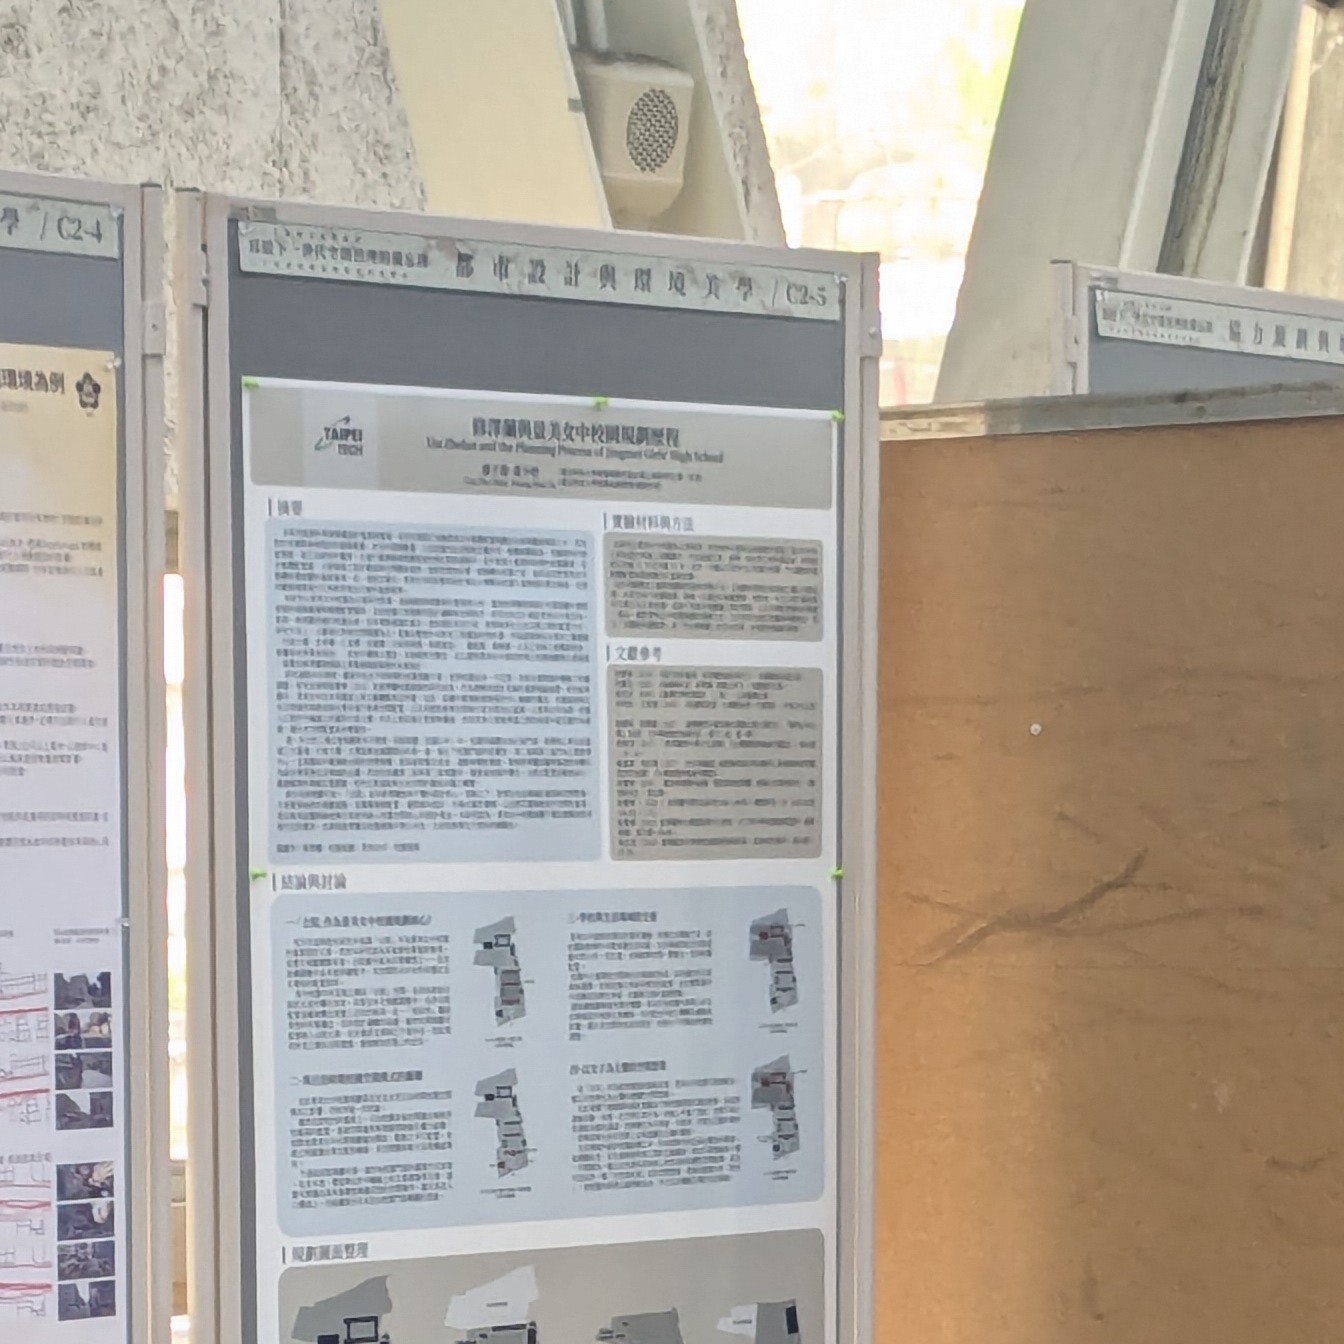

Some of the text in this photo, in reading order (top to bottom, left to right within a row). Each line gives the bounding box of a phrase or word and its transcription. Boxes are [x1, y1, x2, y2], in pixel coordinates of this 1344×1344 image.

[457, 252, 754, 302] 都市設計與環境美學
[323, 426, 363, 442] TAIPEI
